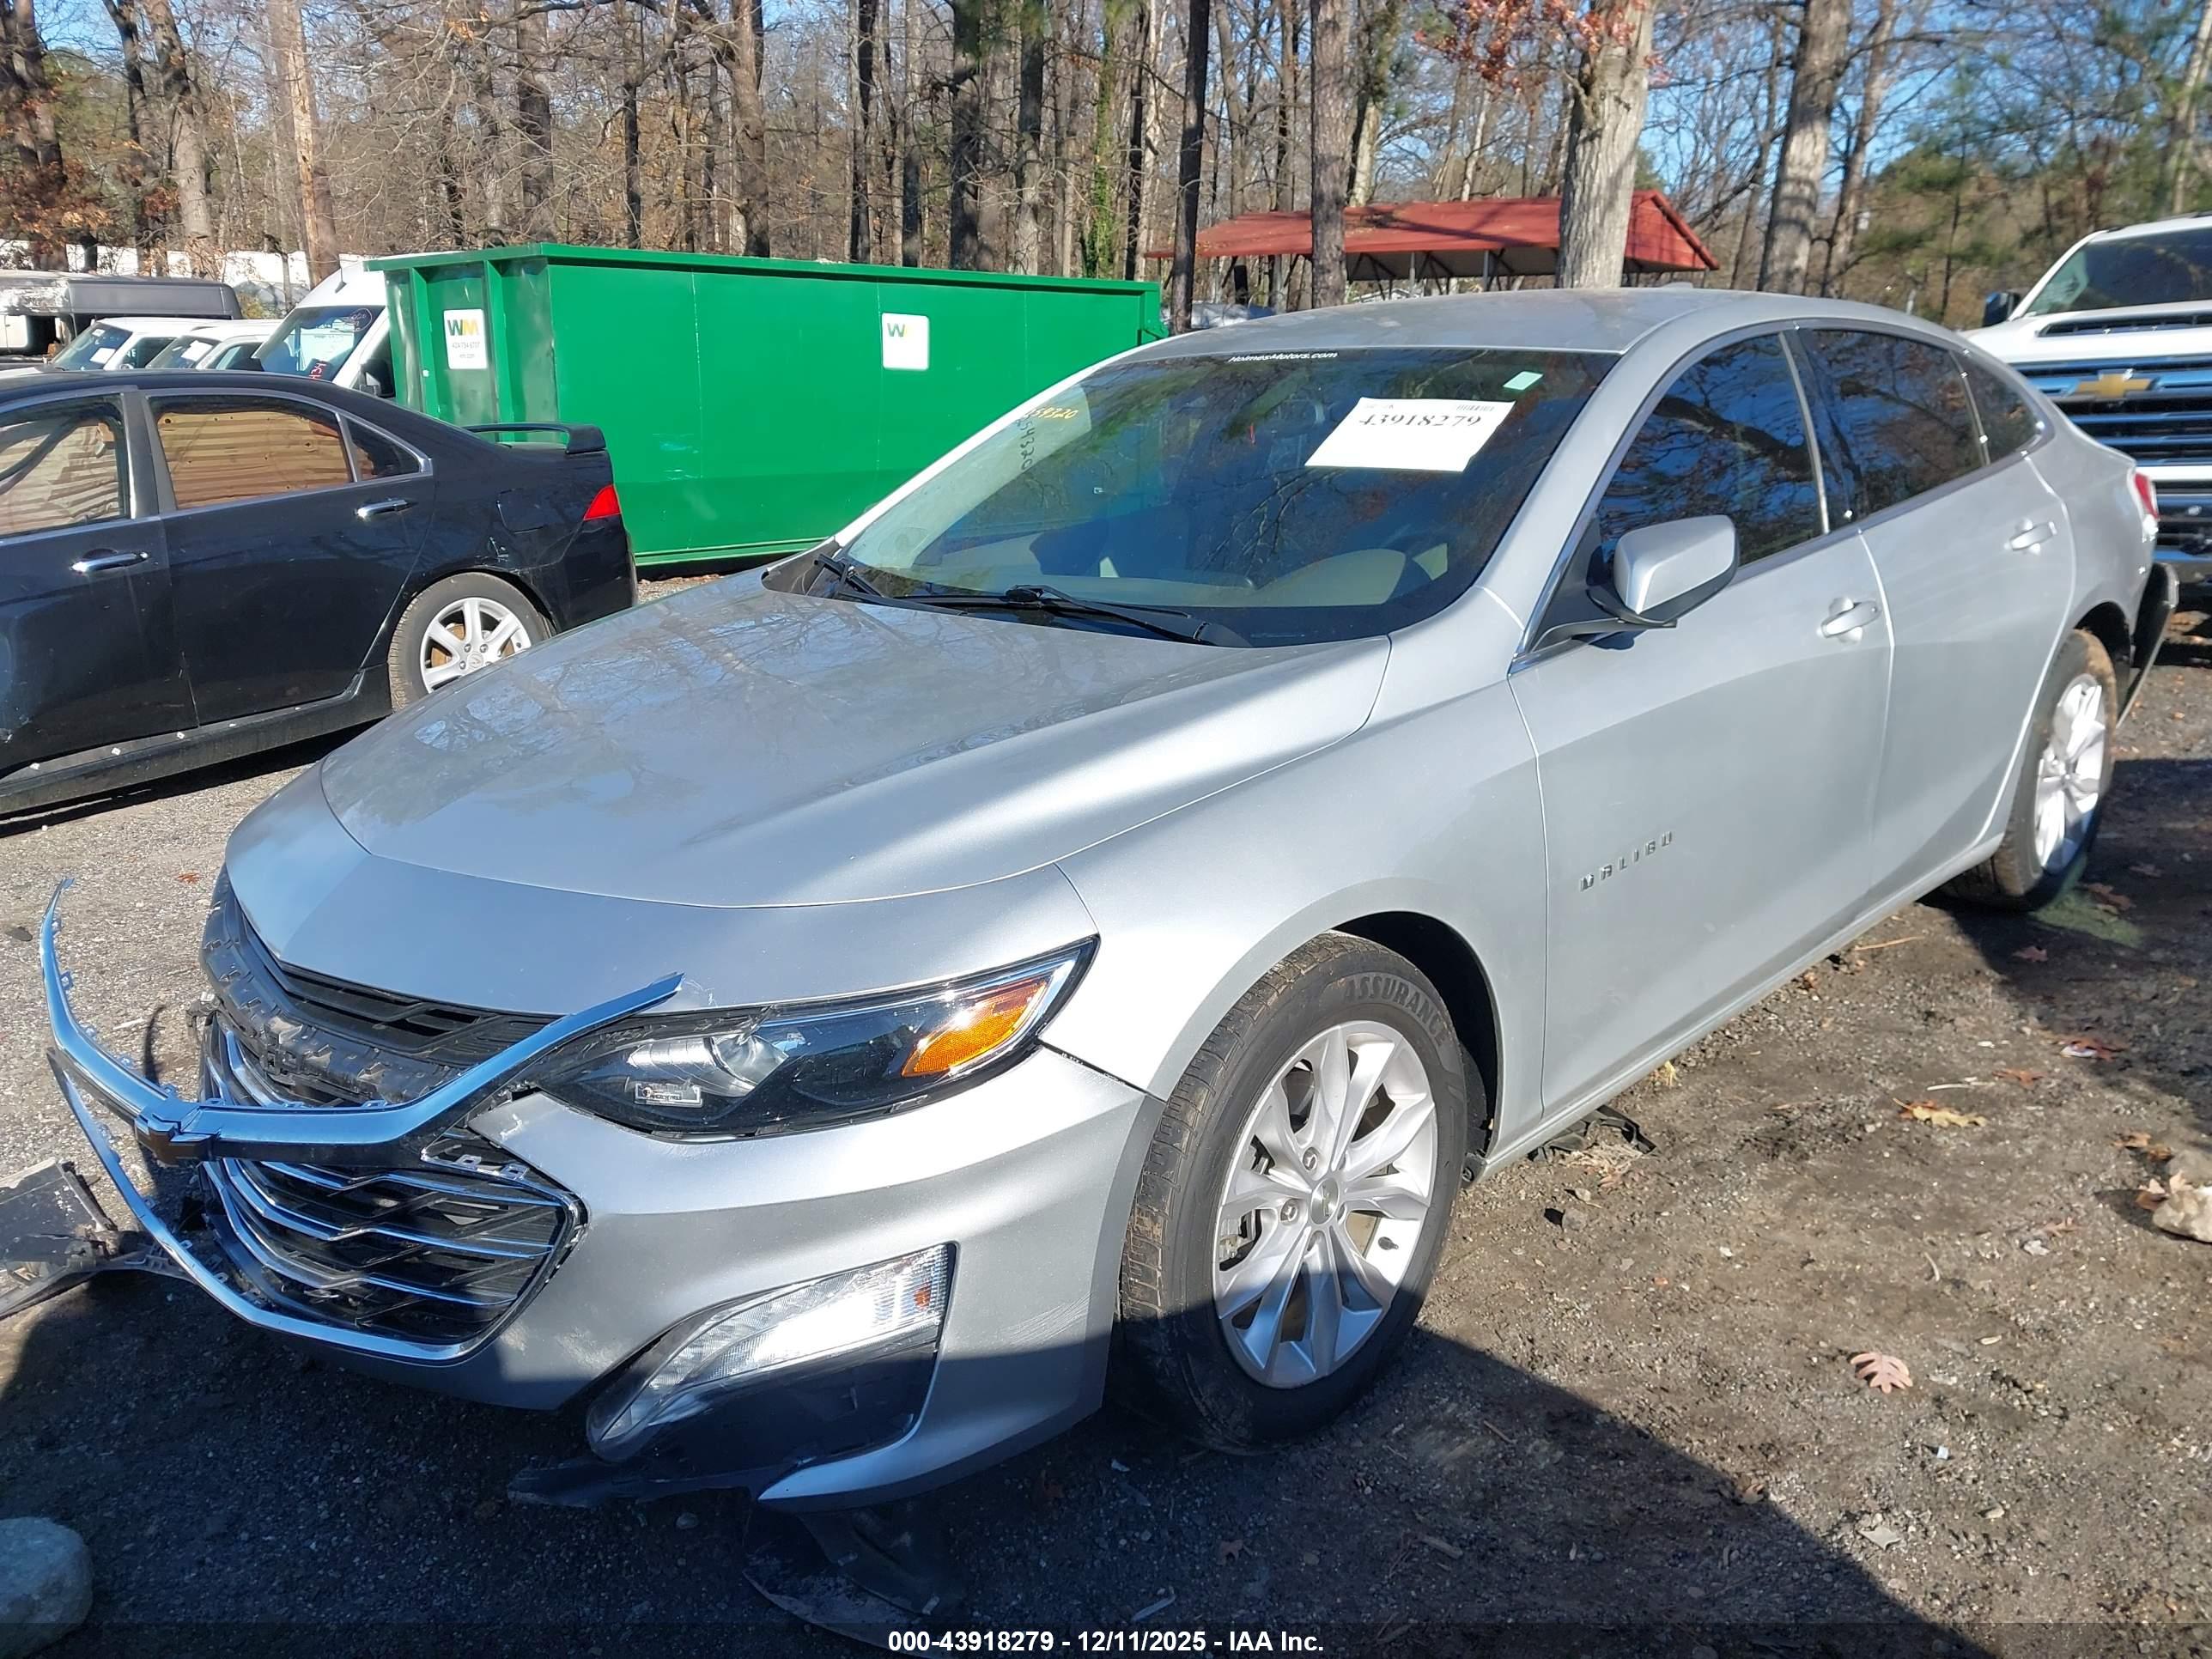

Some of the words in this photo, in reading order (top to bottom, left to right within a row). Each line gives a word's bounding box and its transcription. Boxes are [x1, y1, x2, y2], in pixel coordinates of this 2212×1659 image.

[447, 319, 479, 336] WM
[1359, 414, 1490, 427] 43918279
[1580, 830, 1673, 891] MALIBU
[1344, 975, 1452, 1047] ASSURANCE
